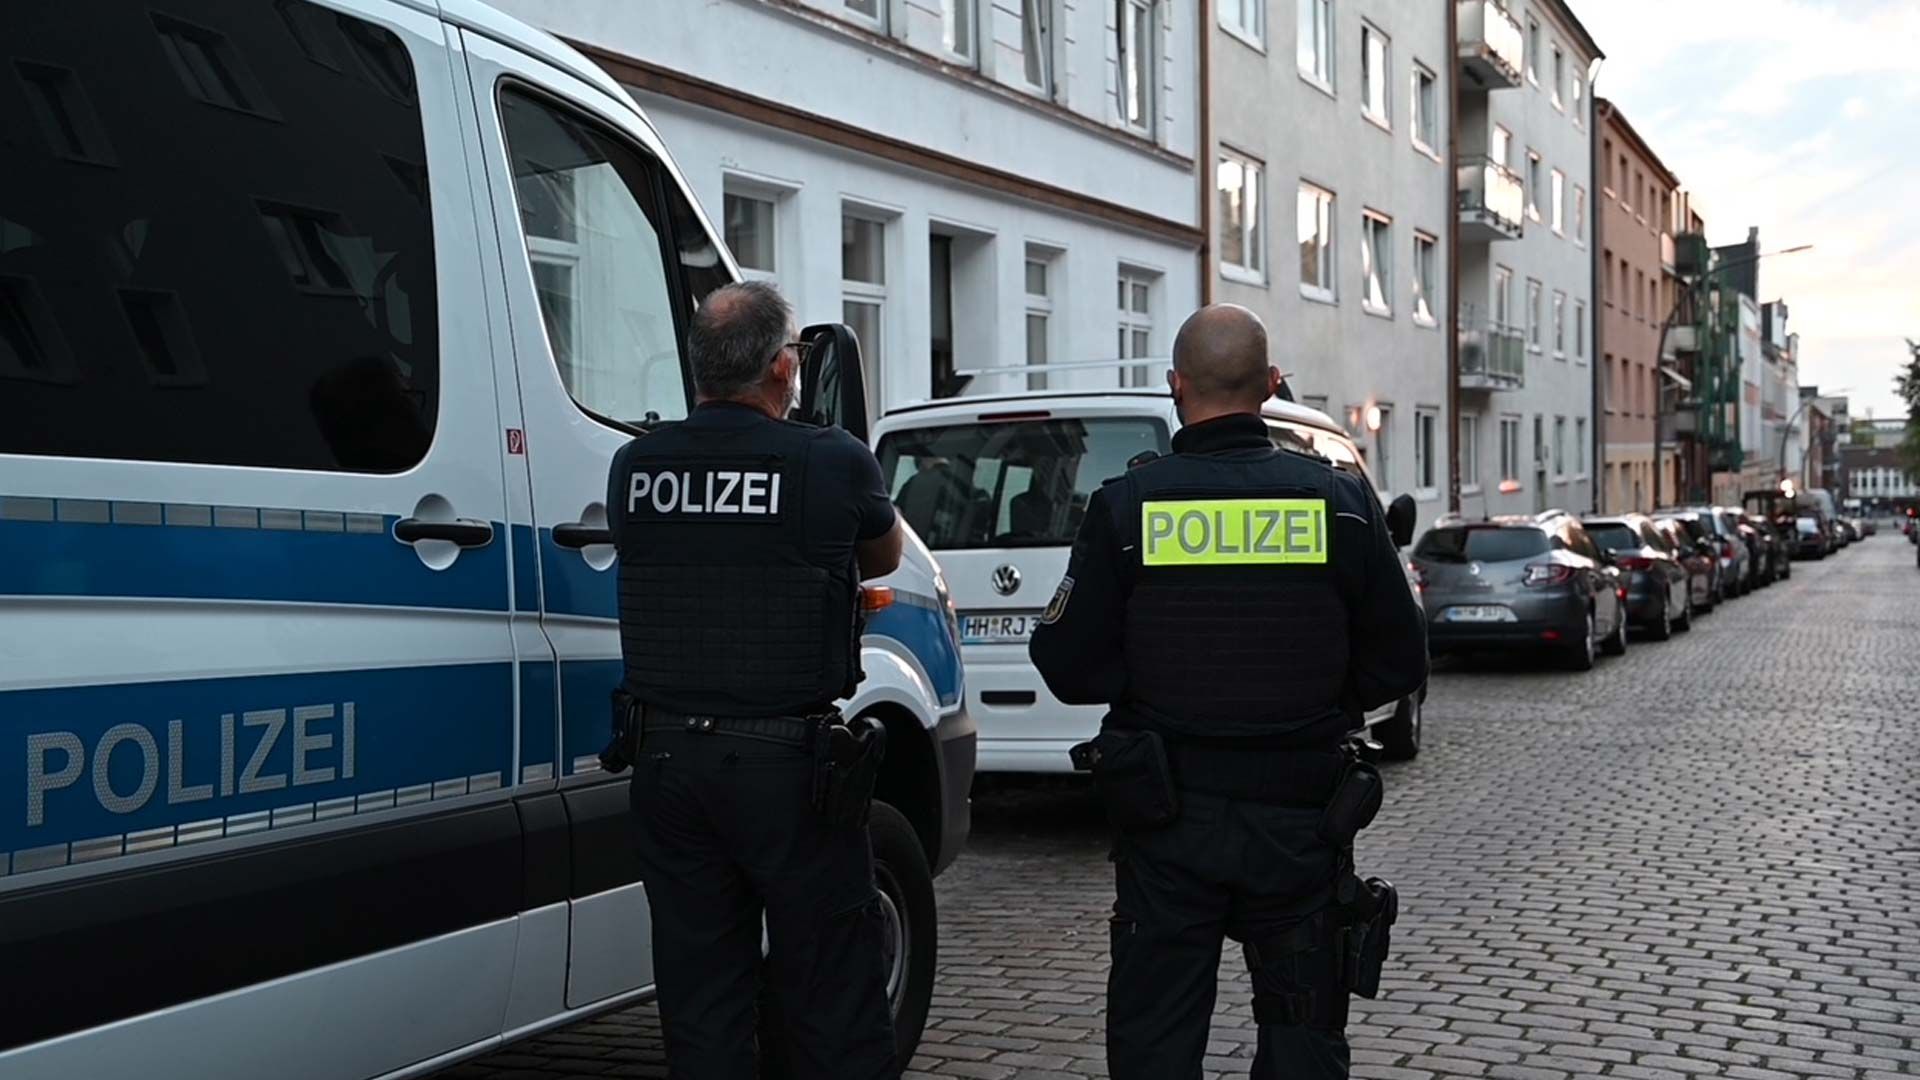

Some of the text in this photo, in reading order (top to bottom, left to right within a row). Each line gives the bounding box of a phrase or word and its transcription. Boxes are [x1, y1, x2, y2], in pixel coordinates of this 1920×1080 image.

[628, 471, 781, 514] POLIZEI
[1147, 509, 1322, 555] POLIZEI
[965, 616, 990, 636] HH
[27, 702, 355, 826] POLIZEI
